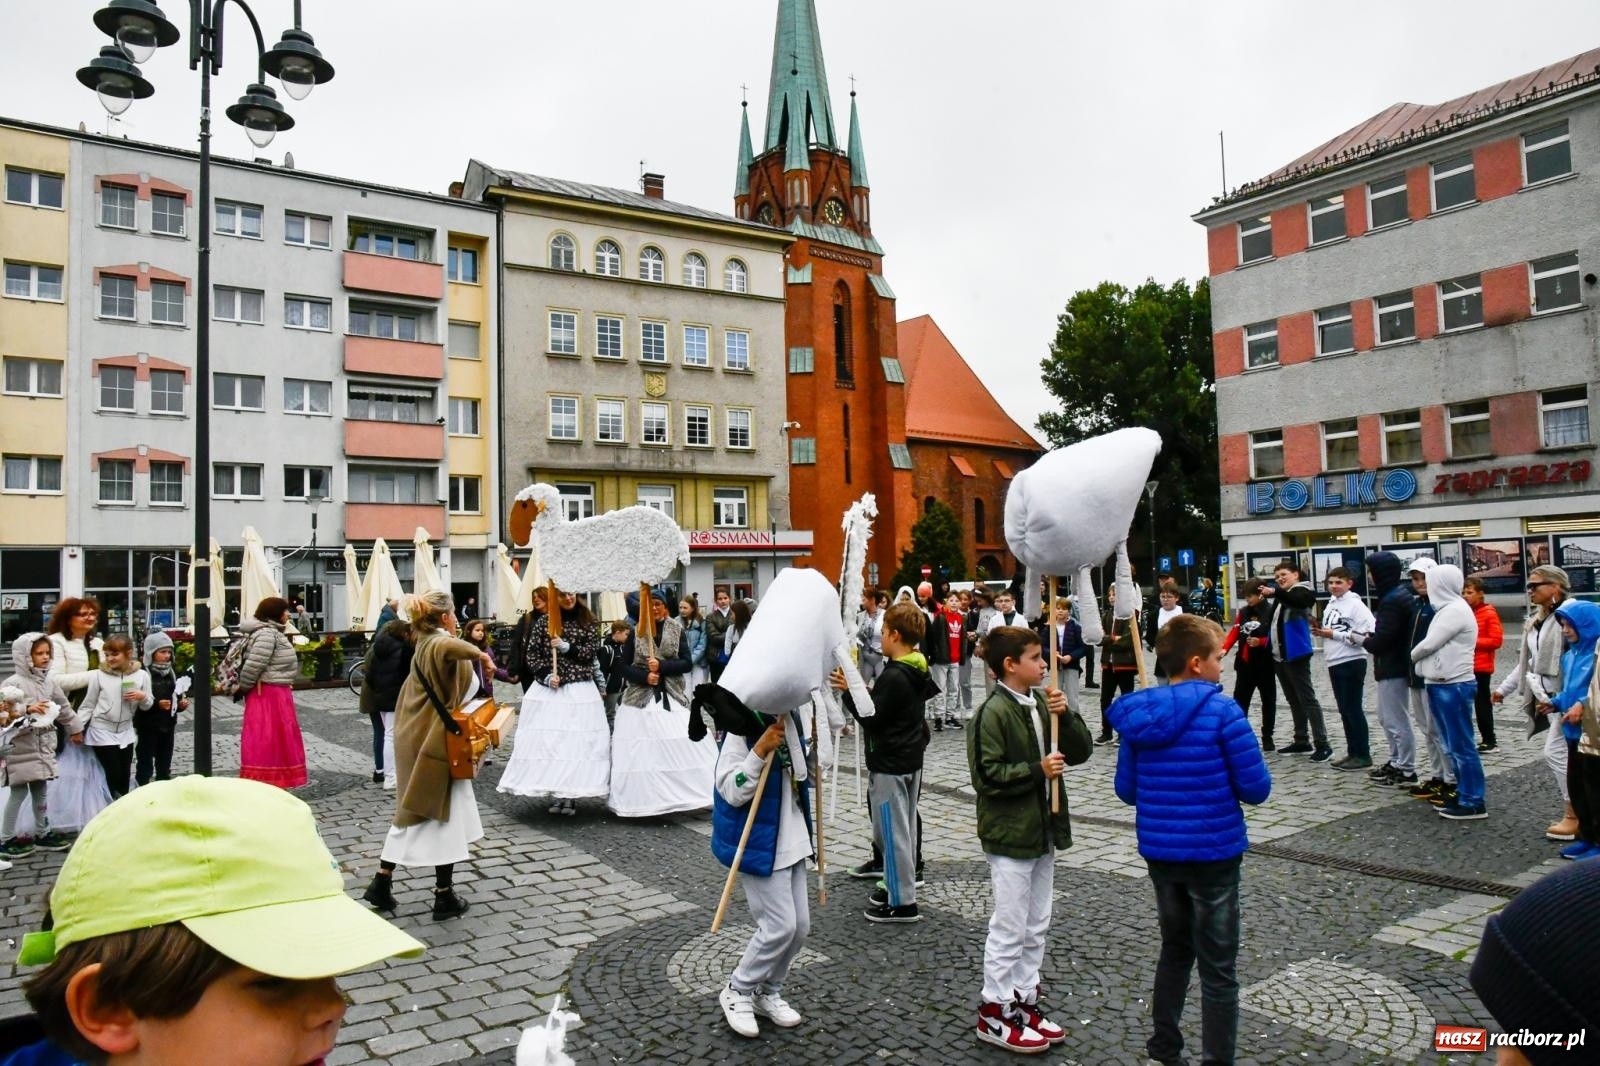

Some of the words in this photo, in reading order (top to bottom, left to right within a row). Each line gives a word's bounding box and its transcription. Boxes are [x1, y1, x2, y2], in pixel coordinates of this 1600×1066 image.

[1247, 468, 1418, 515] BOLKO
[1432, 459, 1592, 497] zaprasza
[690, 531, 770, 544] ROSSMANN
